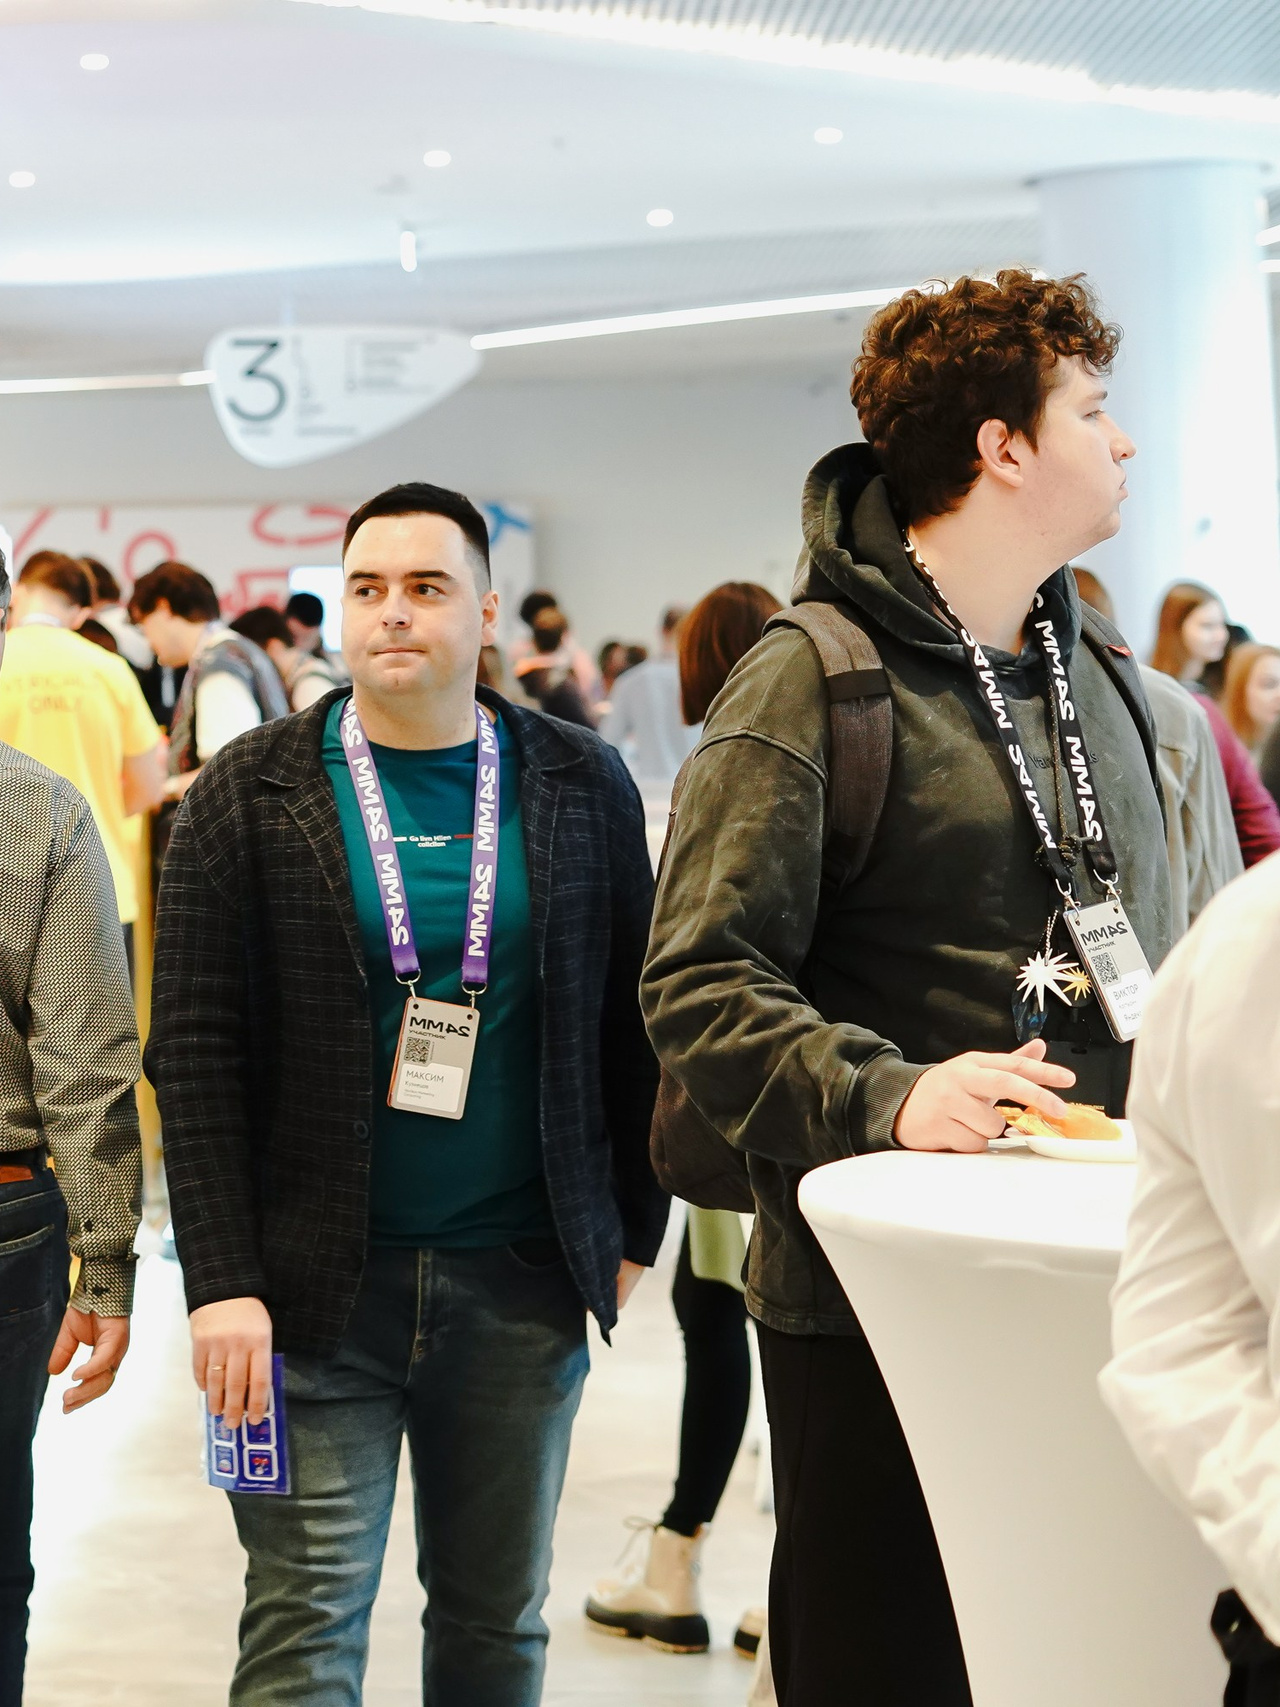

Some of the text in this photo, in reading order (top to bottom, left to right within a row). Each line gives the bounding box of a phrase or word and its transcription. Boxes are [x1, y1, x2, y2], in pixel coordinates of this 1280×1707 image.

[227, 337, 287, 422] 3
[1087, 941, 1117, 953] УЧАСТНИК
[1113, 983, 1139, 1000] ВИКТОР
[409, 1029, 447, 1040] УЧАСТНИК
[406, 1070, 445, 1083] МАКСИМ
